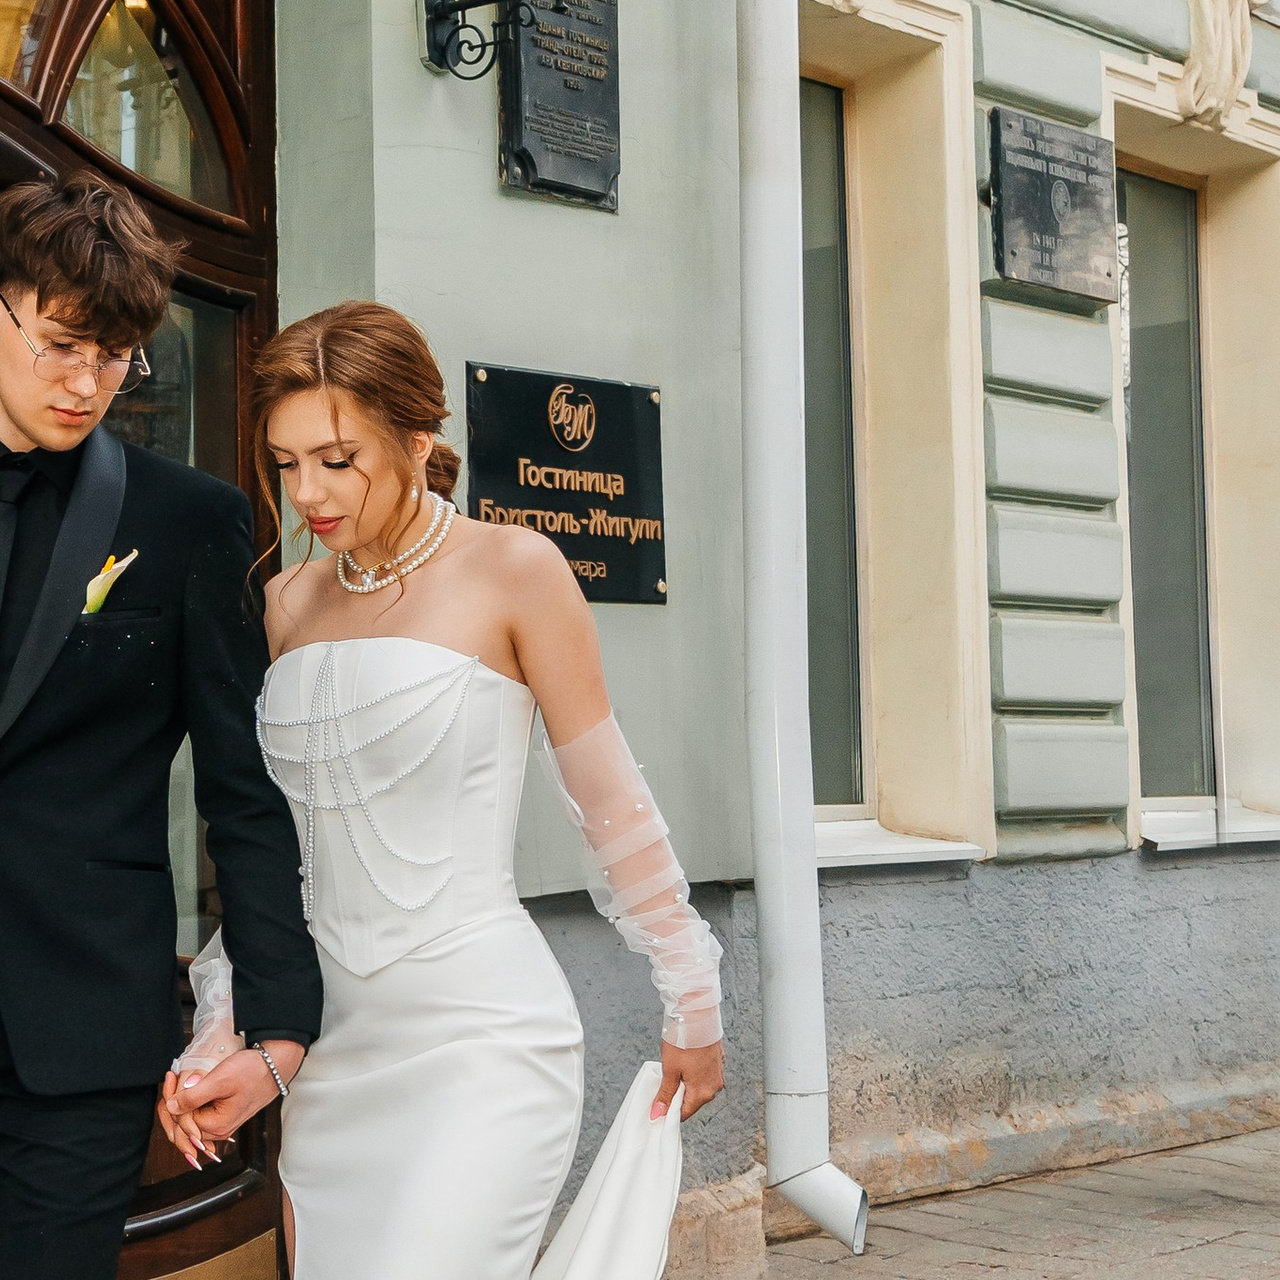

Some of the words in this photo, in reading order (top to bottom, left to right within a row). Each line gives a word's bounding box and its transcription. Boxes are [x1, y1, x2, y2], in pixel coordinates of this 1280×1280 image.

[517, 457, 625, 502] Гостиница
[478, 498, 662, 545] Бристоль-Жигули
[567, 559, 608, 582] мара
